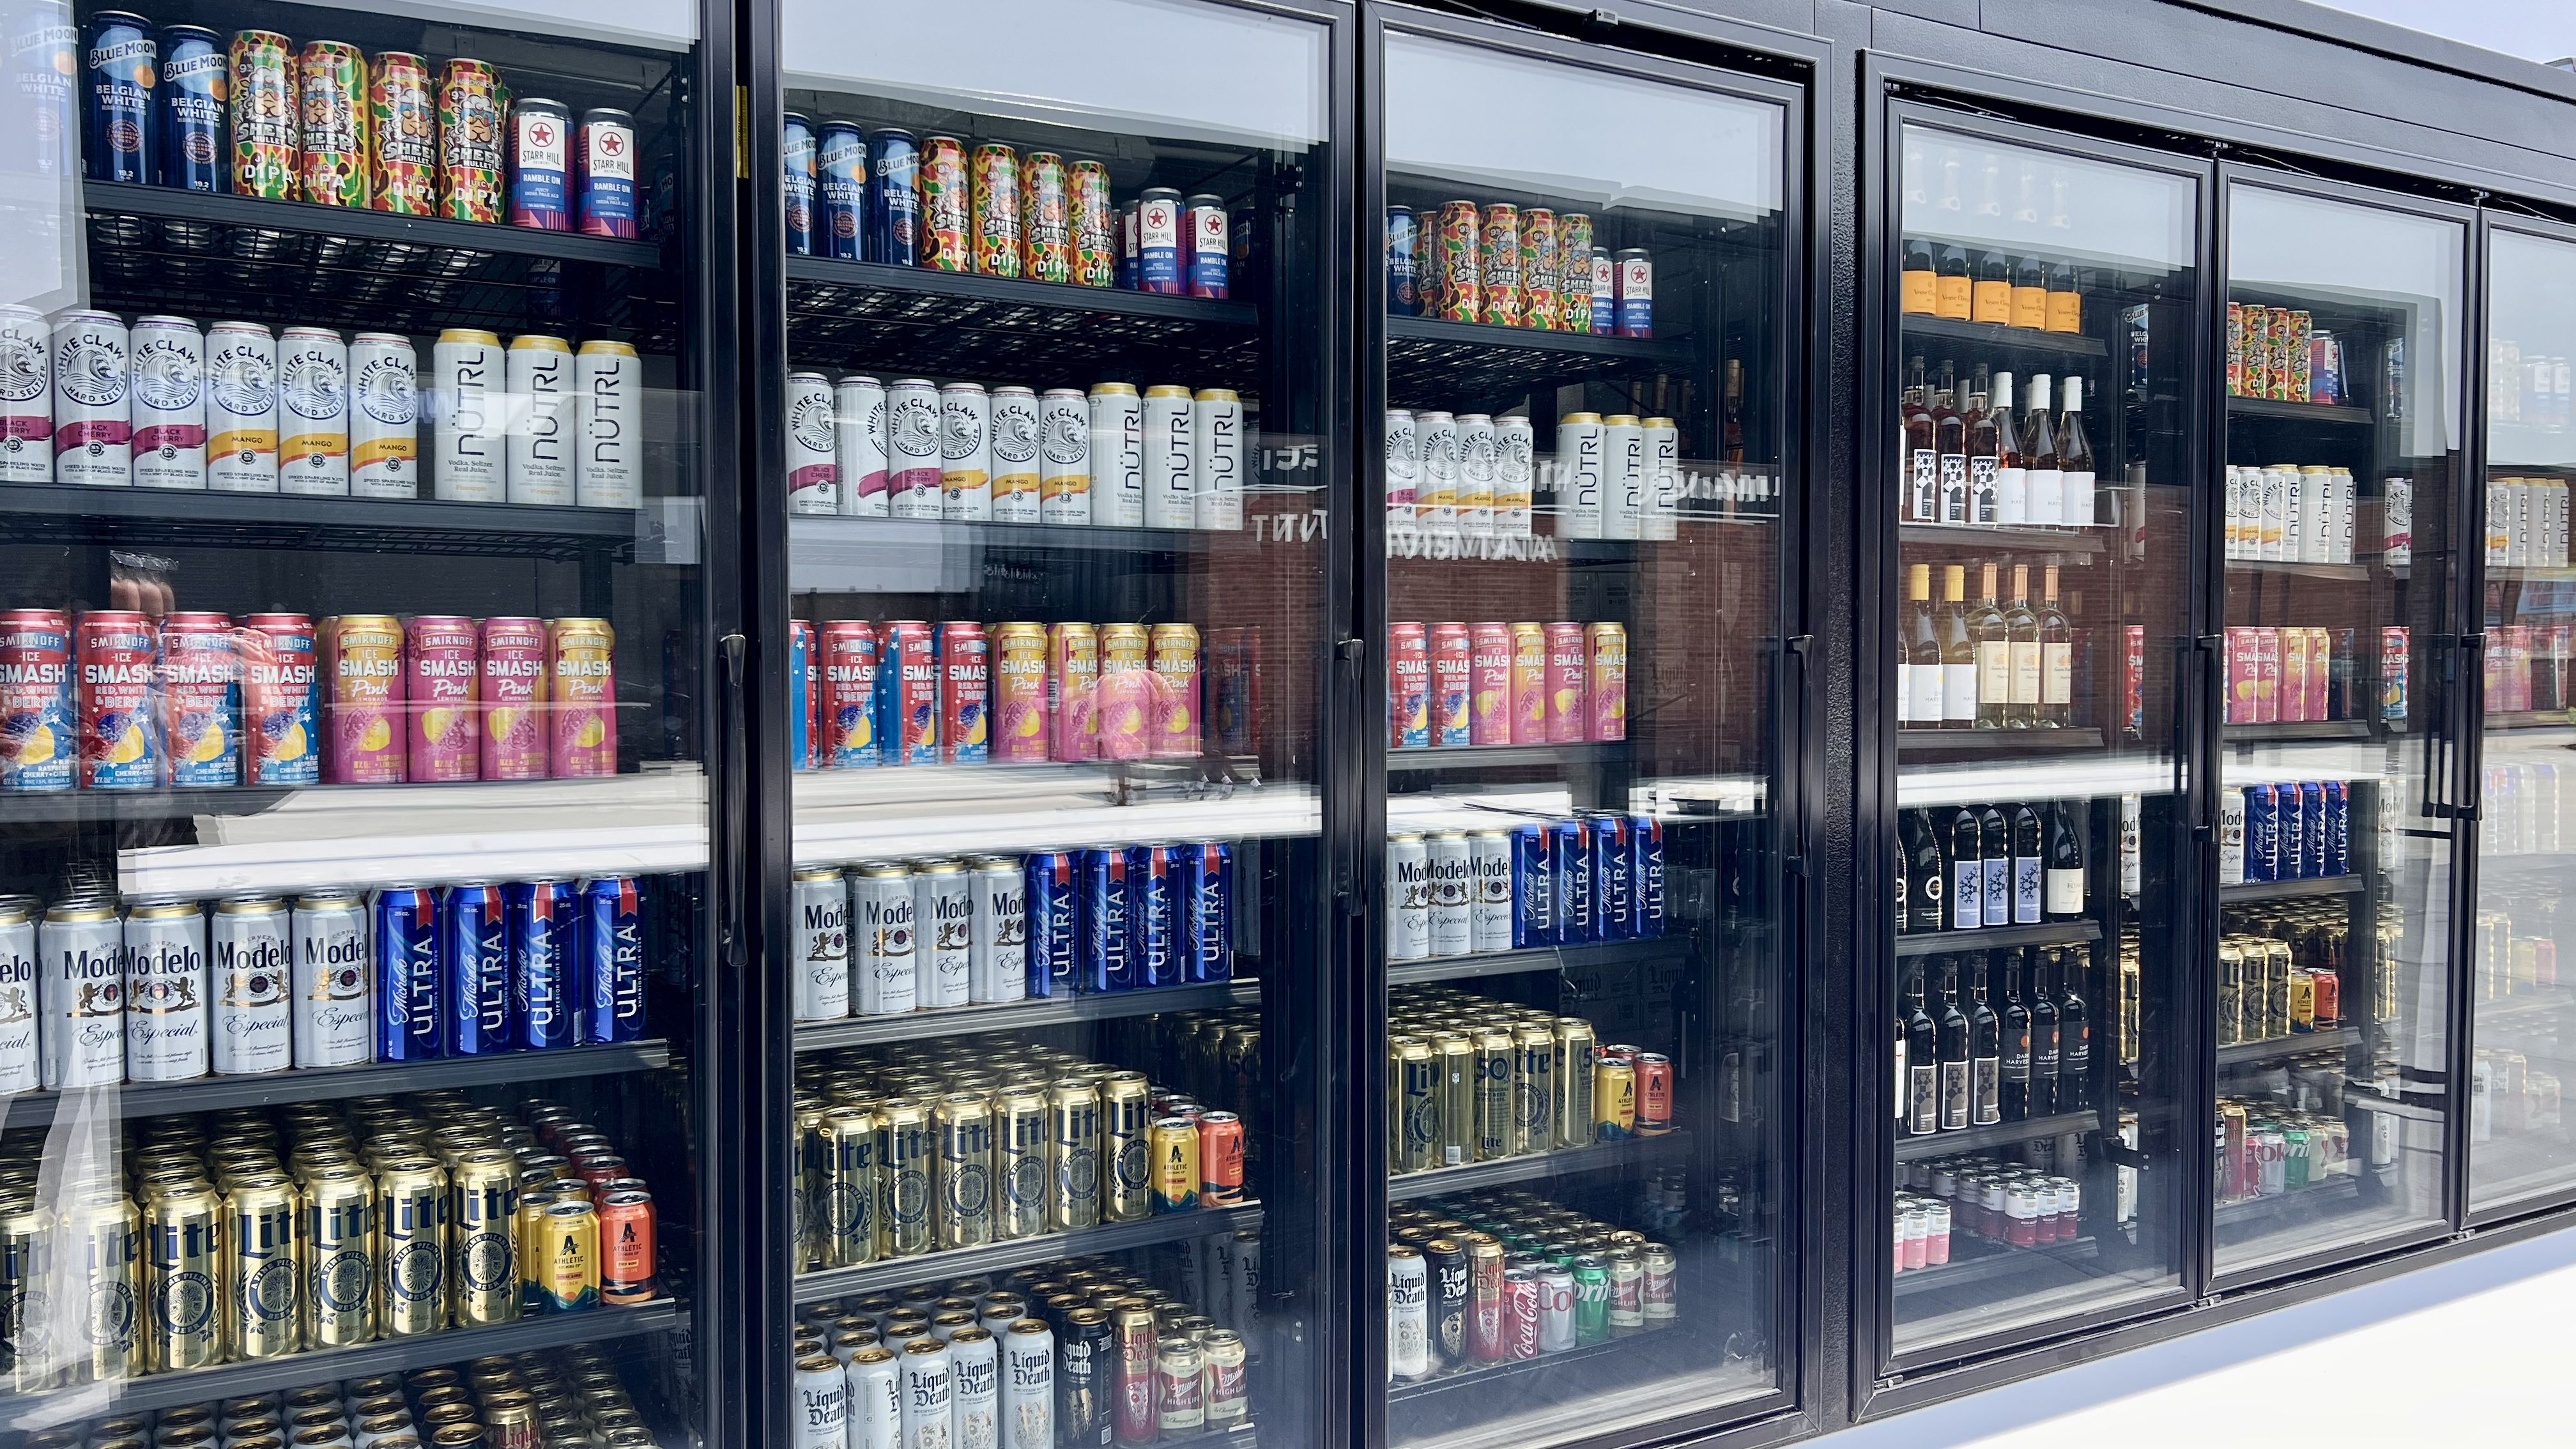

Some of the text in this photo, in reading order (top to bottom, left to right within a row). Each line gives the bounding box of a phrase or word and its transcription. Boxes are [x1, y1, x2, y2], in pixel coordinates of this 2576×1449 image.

[91, 42, 156, 66] BLUE MOON
[165, 56, 227, 79] BLUE MOON
[96, 86, 150, 100] BELGIAN
[102, 95, 145, 109] WHITE
[171, 97, 224, 113] BELGIAN
[177, 108, 220, 121] WHITE
[238, 123, 298, 148] SHEEP
[253, 136, 284, 146] MULLET
[463, 160, 493, 169] MULLET
[523, 151, 560, 165] STARR HILL
[818, 145, 866, 168] BLUE MOON
[245, 166, 293, 183] DIPA
[594, 160, 629, 173] STARR HILL
[523, 174, 560, 185] RAMBLE ON
[594, 183, 630, 193] RAMBLE ON
[823, 183, 863, 194] BELGIAN
[455, 187, 499, 206] DIPA
[827, 191, 859, 201] WHITE
[889, 197, 918, 208] WHITE
[1144, 232, 1172, 242] STARR HILL
[58, 335, 125, 379] WHITE CLAW
[134, 341, 197, 385] WHITE CLAW
[212, 346, 274, 390] WHITE CLAW
[282, 351, 344, 394] WHITE CLAW
[67, 369, 125, 402] HARD SELTZER
[142, 375, 199, 407] HARD SELTZER
[222, 381, 275, 411] HARD SELTZER
[293, 385, 344, 416] HARD SELTZER
[893, 399, 938, 436] WHITE CLAW
[992, 406, 1037, 443] WHITE CLAW
[1041, 408, 1085, 445] WHITE CLAW
[231, 436, 263, 444] MANGO
[1423, 432, 1440, 461] WHITE
[91, 638, 148, 648] SMIRNOFF
[256, 639, 310, 648] SMIRNOFF
[344, 636, 394, 645] SMIRNOFF
[426, 637, 473, 647] SMIRNOFF
[562, 638, 608, 647] SMIRNOFF
[832, 643, 873, 652] SMIRNOFF
[115, 653, 132, 663] ICE
[279, 654, 294, 663] ICE
[362, 650, 377, 659] ICE
[444, 650, 459, 660] ICE
[1476, 655, 1510, 666] SMASH
[85, 665, 153, 683] SMASH
[252, 666, 314, 683] SMASH
[340, 660, 398, 676] SMASH
[420, 661, 476, 676] SMASH
[557, 661, 611, 676] SMASH
[827, 666, 877, 680] SMASH
[1002, 660, 1045, 673] SMASH
[1104, 660, 1147, 673] SMASH
[1153, 660, 1195, 673] SMASH
[1011, 677, 1038, 691] Pink
[1485, 670, 1506, 682] Pink
[352, 680, 388, 696] Pink
[433, 679, 468, 696] Pink
[569, 679, 603, 696] Pink
[105, 697, 146, 707] BERRY
[2337, 806, 2347, 862] ULTRA
[1427, 859, 1470, 880] Modelo
[1602, 867, 1611, 913] Michelob
[1614, 852, 1625, 923] ULTRA
[1650, 849, 1661, 919] ULTRA
[1524, 873, 1533, 919] Michelob
[1538, 858, 1550, 929] ULTRA
[1149, 886, 1165, 967] ULTRA
[1202, 882, 1219, 962] ULTRA
[1428, 912, 1469, 926] Especial
[1054, 893, 1070, 976] ULTRA
[1107, 889, 1123, 971] ULTRA
[125, 946, 200, 974] Modelo
[218, 941, 291, 969] Modelo
[532, 930, 552, 1025] ULTRA
[597, 945, 612, 1008] Michelob
[617, 923, 636, 1018] ULTRA
[413, 936, 433, 1035] ULTRA
[461, 954, 478, 1020] Michelob
[482, 931, 503, 1029] ULTRA
[516, 948, 528, 1012] Michelob
[390, 958, 408, 1025] Michelob
[130, 1020, 198, 1045] Especial
[226, 1014, 288, 1038] Especial
[818, 1142, 871, 1179] Lite
[383, 1192, 447, 1241] Lite
[455, 1186, 518, 1230] Lite
[149, 1222, 221, 1270] Lite
[613, 1243, 643, 1252] ATHLETIC
[555, 1255, 584, 1264] ATHLETIC
[1392, 1273, 1424, 1295] Liquid
[1646, 1278, 1671, 1291] Miller
[1394, 1289, 1425, 1304] Death
[956, 1357, 994, 1377] Liquid
[1011, 1349, 1049, 1368] Liquid
[910, 1368, 949, 1388] Liquid
[1014, 1369, 1050, 1385] Death
[960, 1378, 995, 1395] Death
[1171, 1380, 1197, 1396] Miller
[914, 1388, 949, 1406] Death
